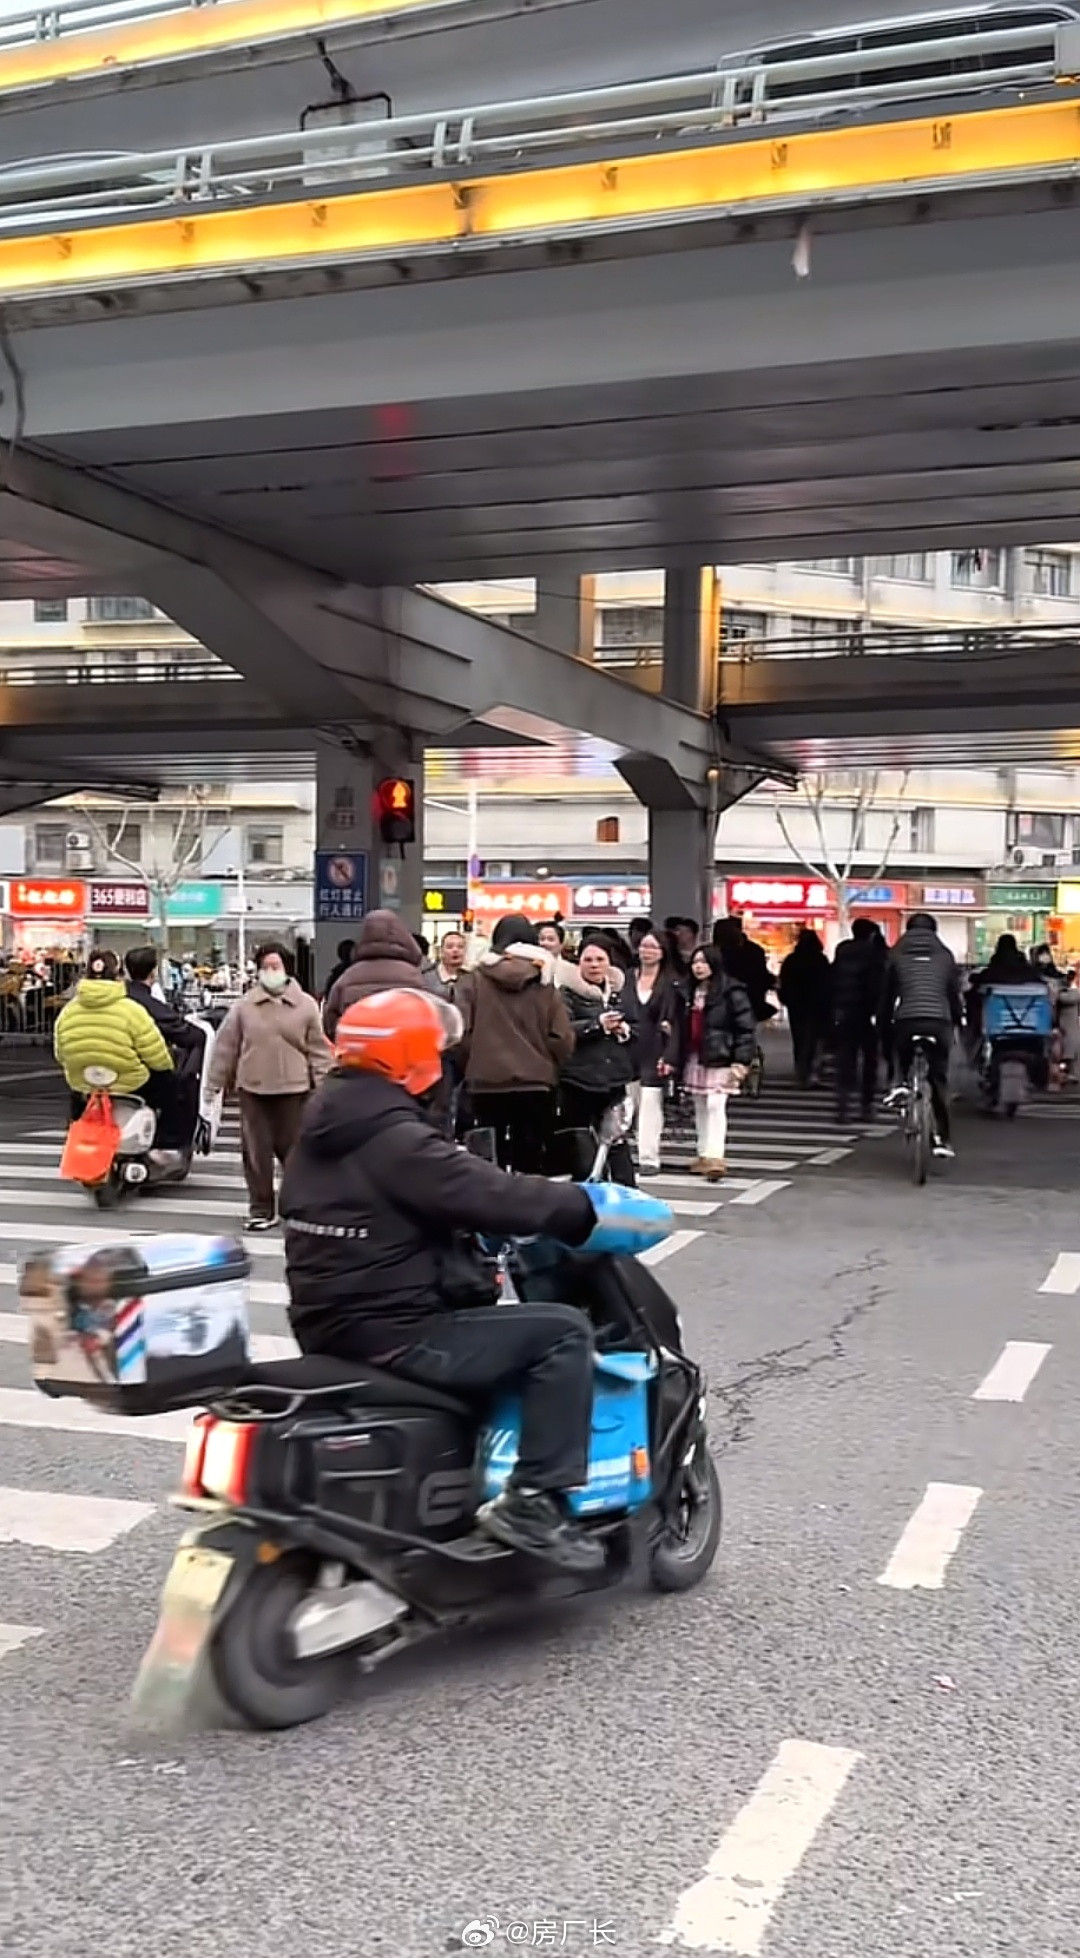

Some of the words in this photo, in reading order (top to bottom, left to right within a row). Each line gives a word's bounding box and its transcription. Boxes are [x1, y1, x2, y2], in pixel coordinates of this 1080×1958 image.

[92, 888, 147, 906] 365便利店
[319, 888, 363, 902] 红灯禁止
[319, 903, 363, 918] 行人通行
